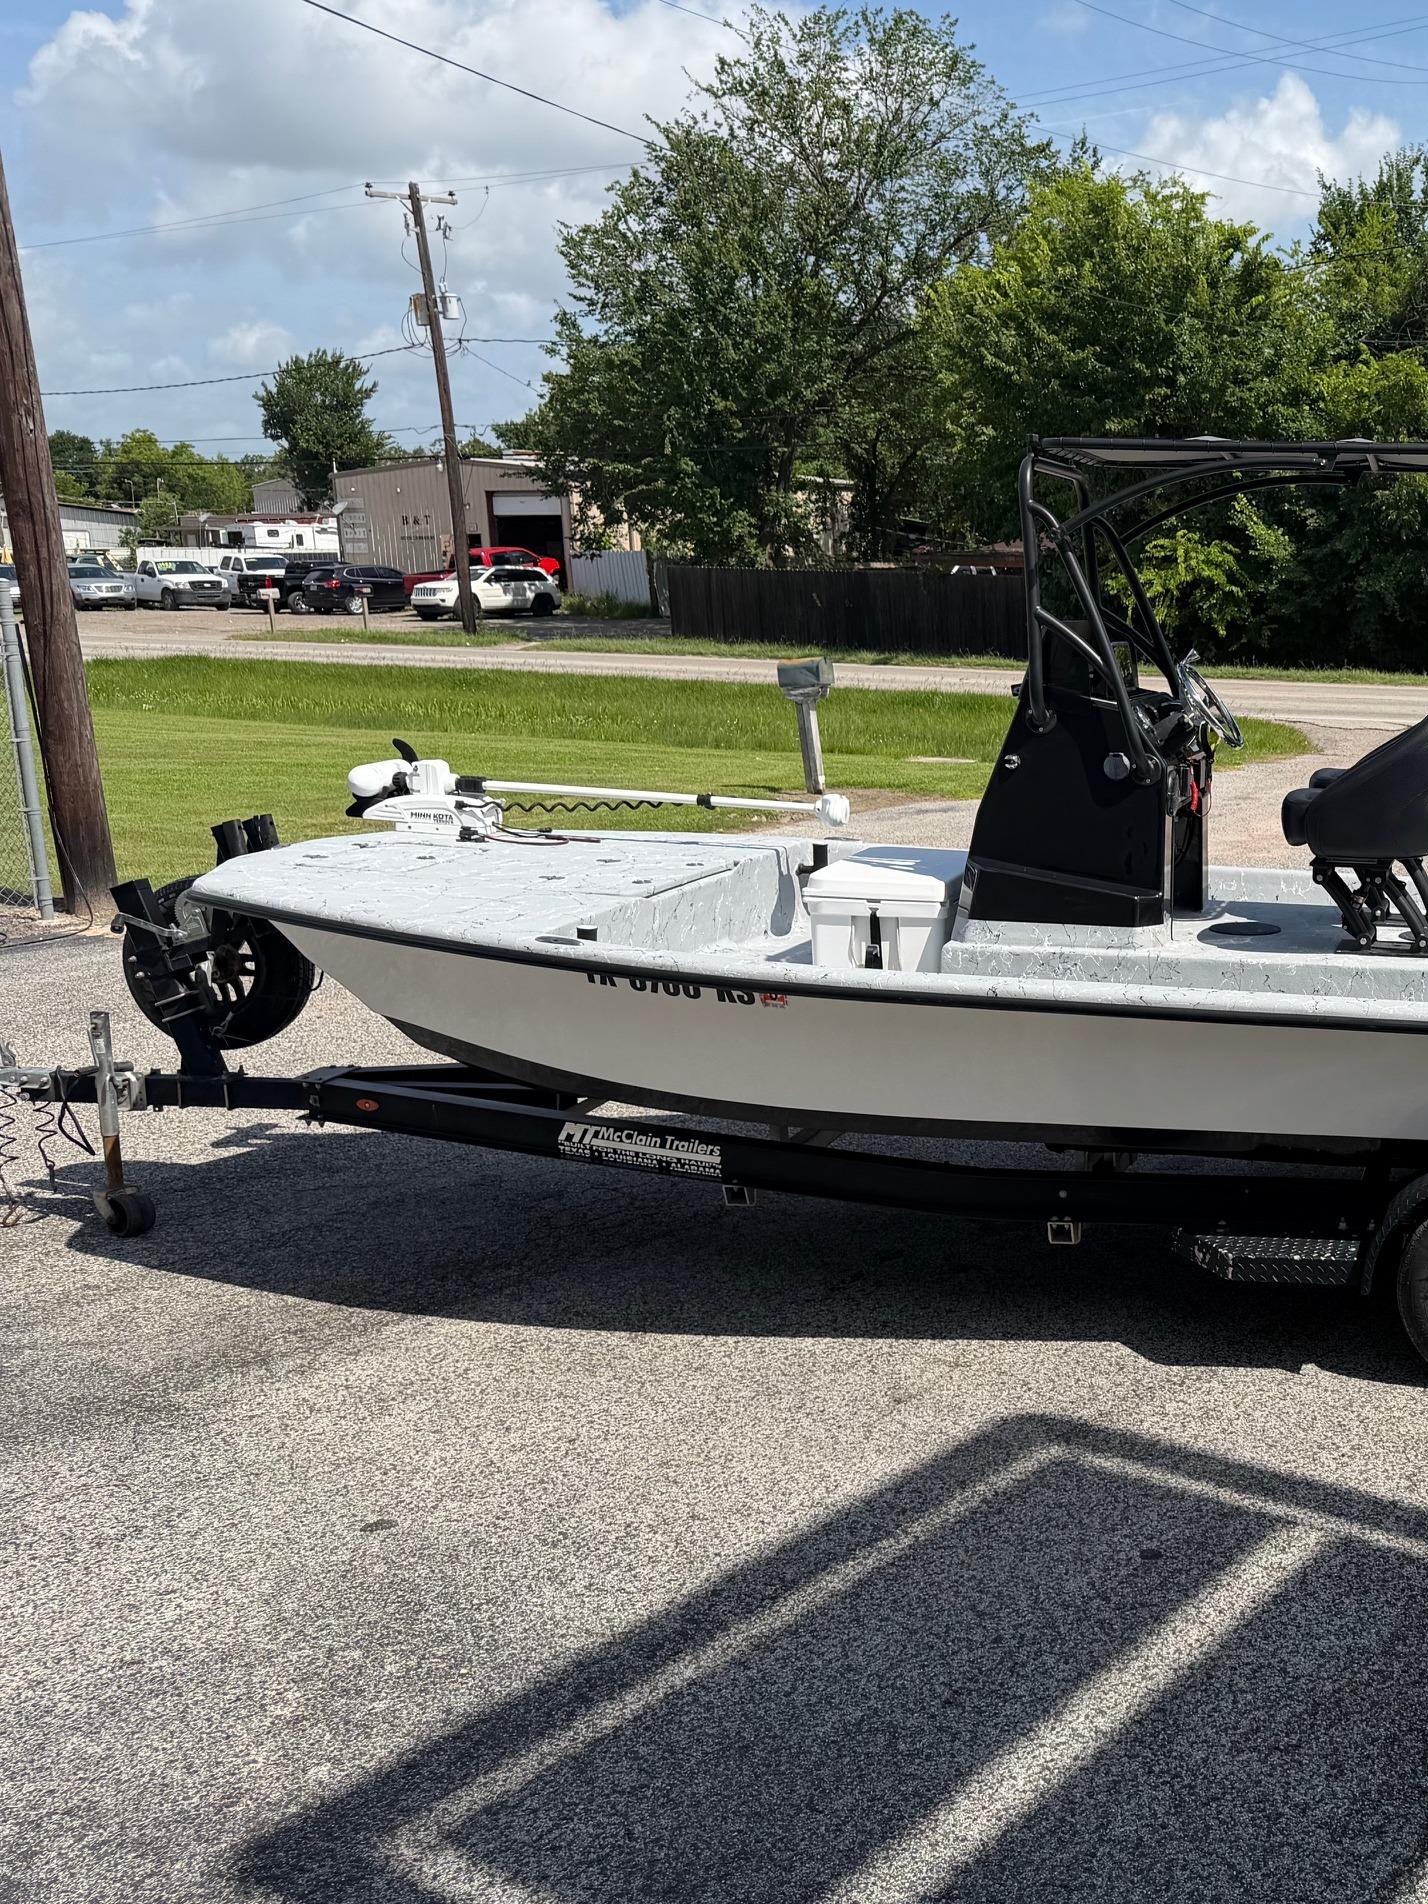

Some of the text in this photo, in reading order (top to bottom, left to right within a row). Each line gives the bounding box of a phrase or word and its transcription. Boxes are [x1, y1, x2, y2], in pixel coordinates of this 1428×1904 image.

[410, 811, 454, 822] MINN KOTA
[598, 1126, 661, 1148] McClain
[665, 1135, 721, 1156] Trailers
[558, 1145, 591, 1157] TEXAS
[669, 1162, 722, 1177] ALABAMA
[616, 1148, 636, 1157] THE
